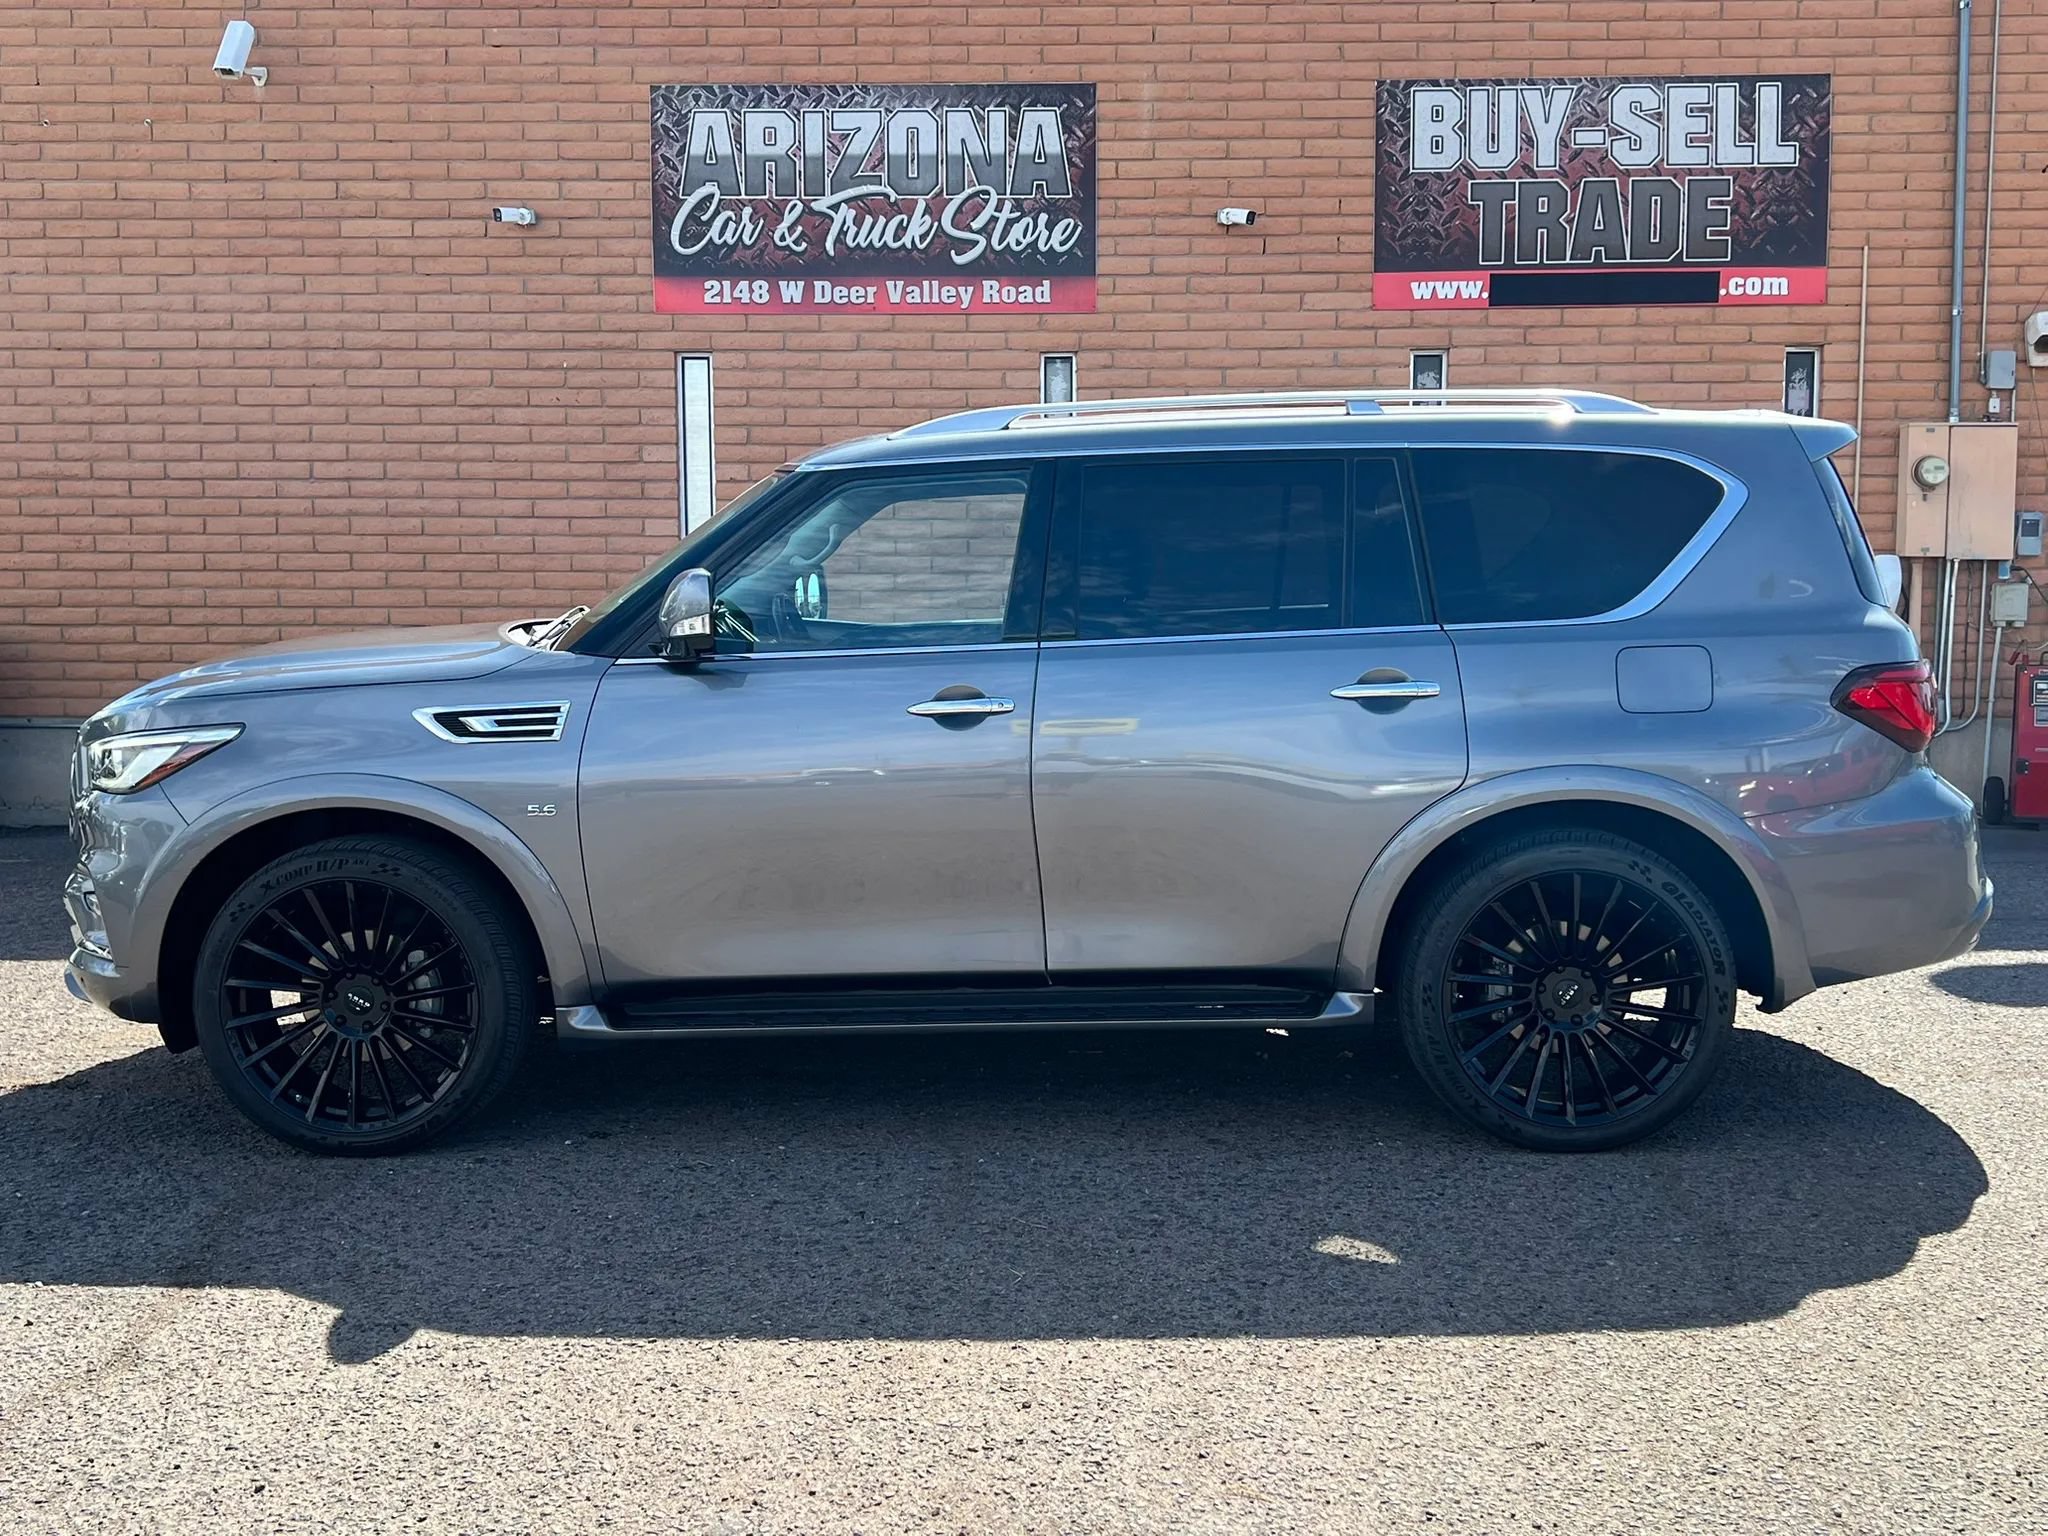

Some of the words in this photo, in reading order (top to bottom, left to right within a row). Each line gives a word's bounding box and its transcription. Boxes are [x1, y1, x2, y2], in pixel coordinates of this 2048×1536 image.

[680, 106, 1073, 199] ARIZONA
[1410, 82, 1800, 173] BUY-SELL
[670, 184, 765, 256] Car
[773, 200, 808, 254] &
[811, 184, 938, 257] Truck
[940, 185, 1083, 266] Store
[1468, 176, 1734, 265] TRADE
[703, 279, 770, 305] 2148
[778, 279, 806, 305] W
[813, 279, 876, 305] Deer
[886, 279, 974, 310] Valley
[982, 278, 1051, 305] Road
[527, 804, 557, 817] 5.6
[1662, 881, 1726, 976] GLADIATOR
